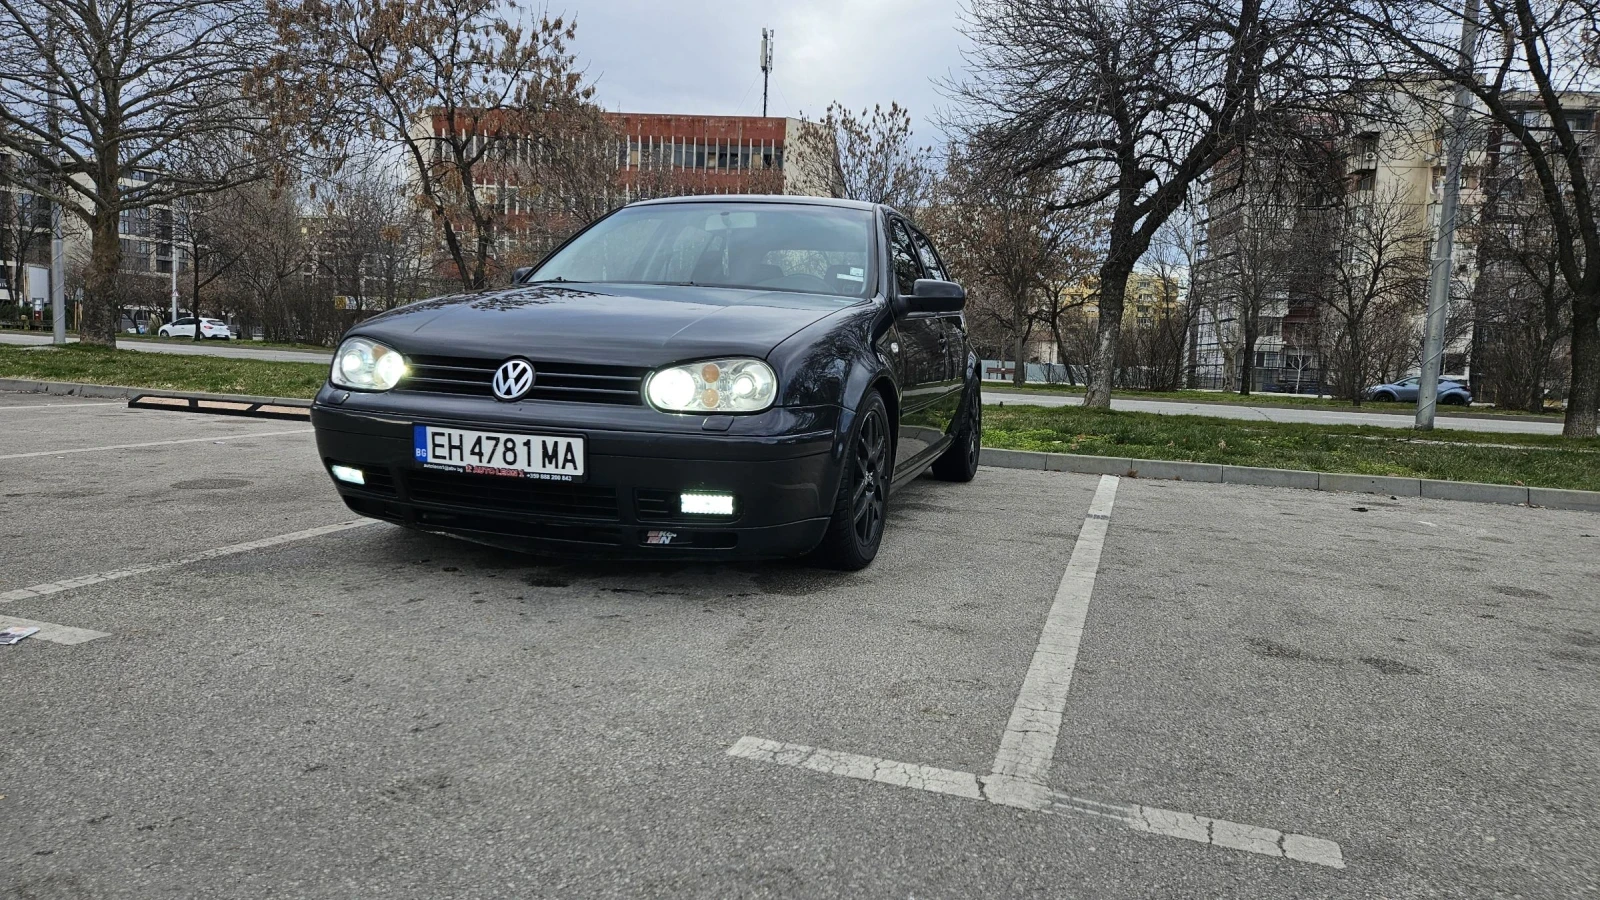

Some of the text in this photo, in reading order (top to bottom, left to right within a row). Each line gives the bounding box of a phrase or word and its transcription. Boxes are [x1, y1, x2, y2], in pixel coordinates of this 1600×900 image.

[493, 361, 533, 398] VW
[416, 448, 427, 457] BG
[431, 431, 578, 471] EH 4781 MA
